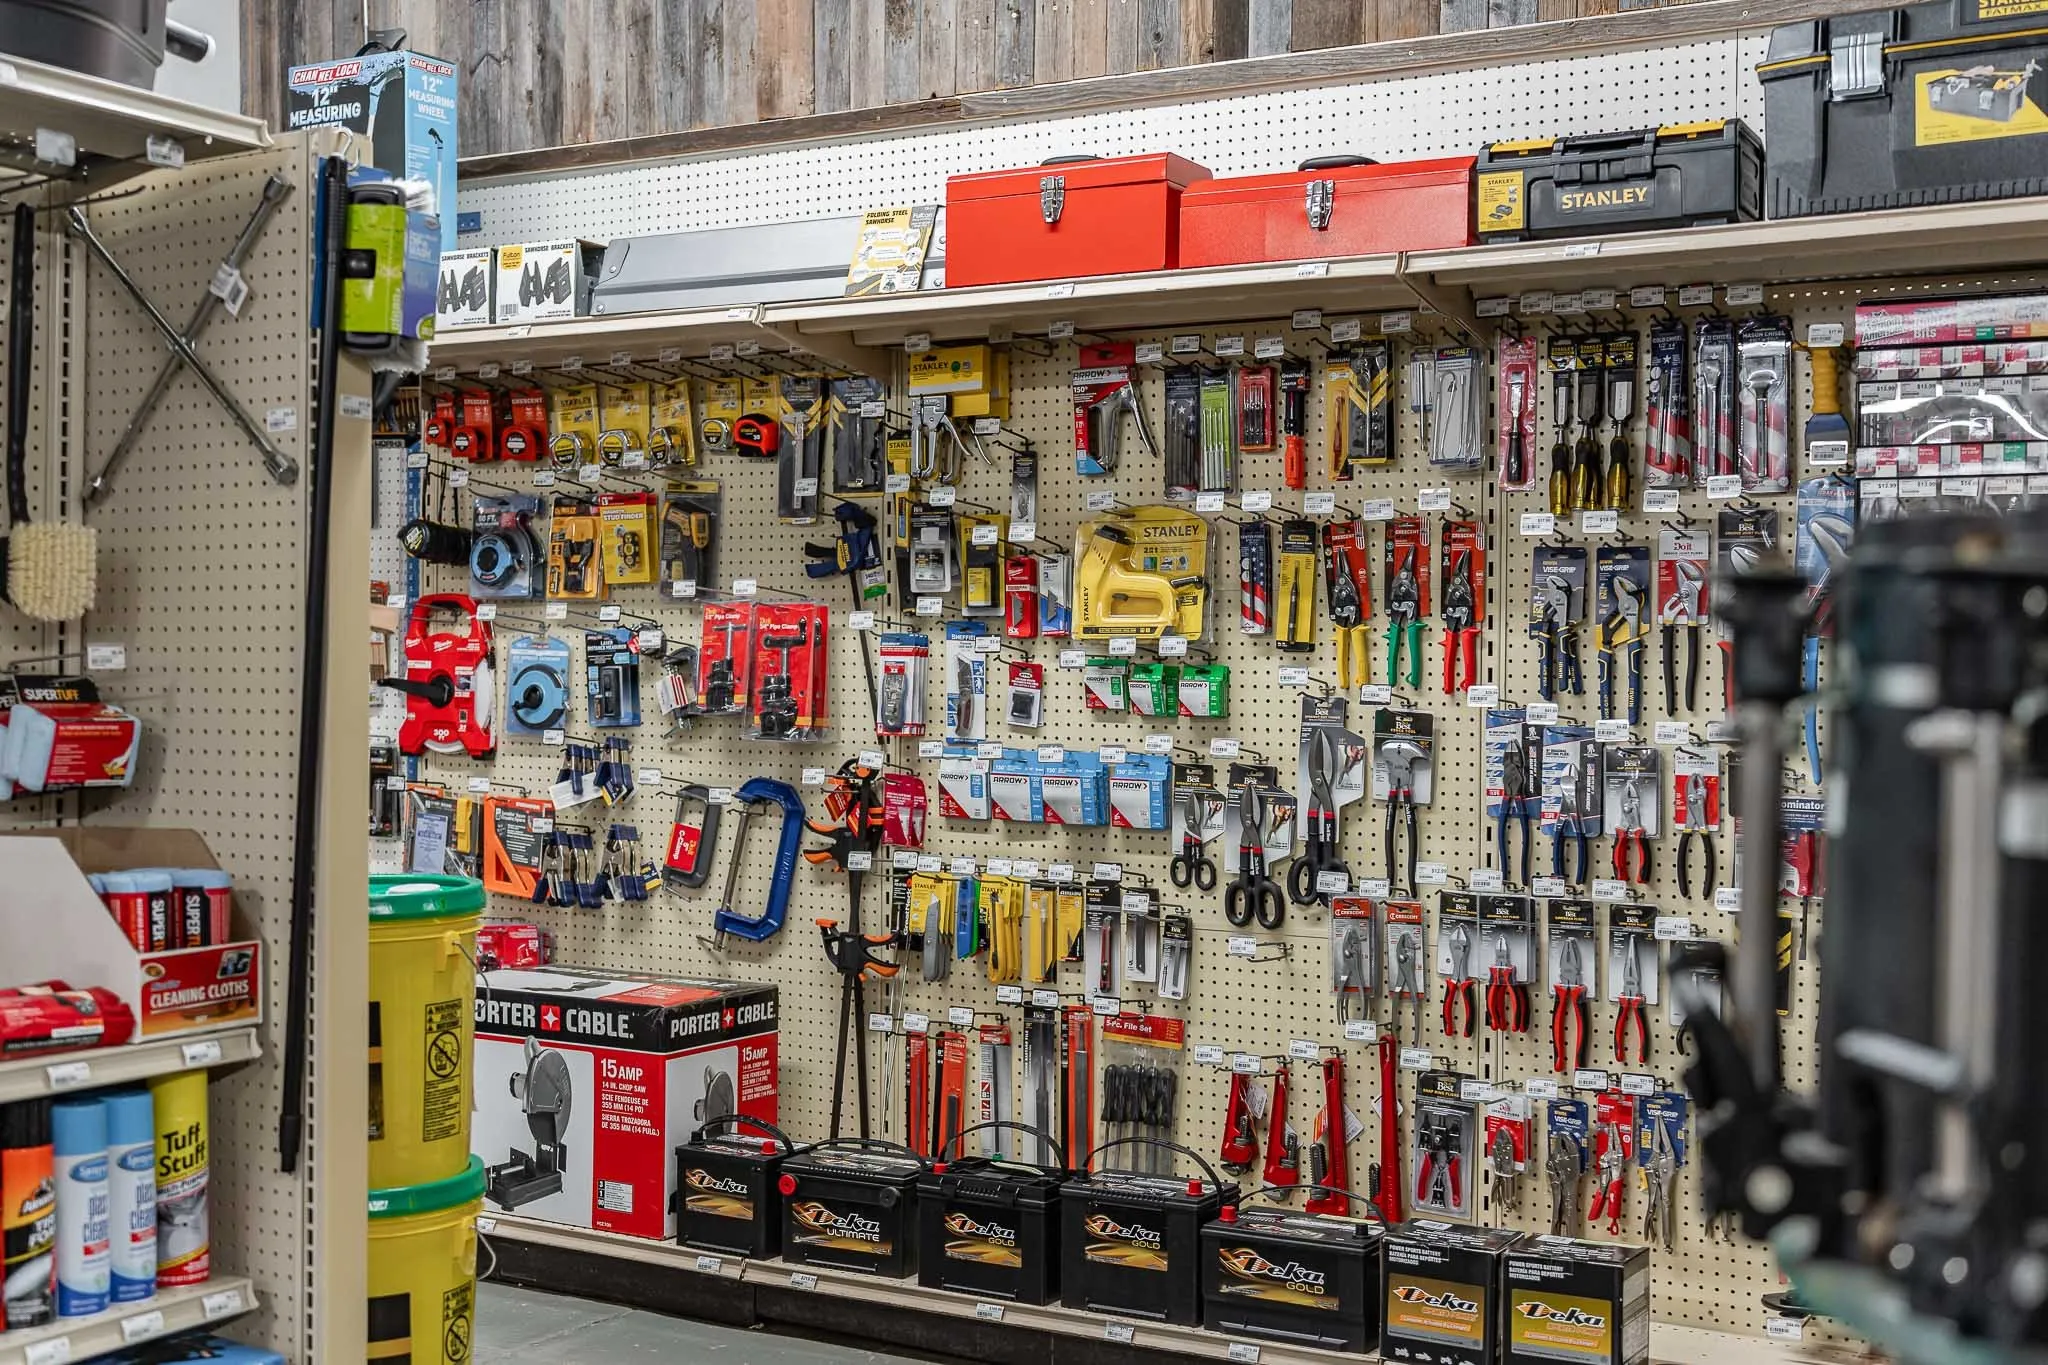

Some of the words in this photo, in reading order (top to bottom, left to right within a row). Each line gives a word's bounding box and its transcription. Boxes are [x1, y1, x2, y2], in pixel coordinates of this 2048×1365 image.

[421, 75, 443, 93] 12"
[312, 87, 338, 107] 12"
[409, 90, 456, 108] MEASURING
[289, 103, 361, 127] MEASURING
[417, 103, 447, 119] WHEEL
[1561, 187, 1648, 209] STANLEY
[467, 252, 489, 260] BRACKETS
[1742, 331, 1763, 339] MASON
[912, 362, 949, 372] STANLEY
[1072, 370, 1105, 379] ARROW
[603, 513, 620, 521] STUD
[621, 512, 644, 520] FINDER
[1143, 525, 1200, 538] STANLEY
[1738, 523, 1755, 532] Best
[1332, 534, 1355, 542] CRESCENT
[1542, 566, 1577, 574] VISE-GRIP
[1599, 564, 1630, 572] VISE-GRIP
[715, 613, 724, 621] Pipe
[725, 612, 741, 621] Clamp
[781, 623, 799, 631] Clamp
[23, 688, 79, 701] SUPERTUFF
[1315, 707, 1329, 716] Best
[1395, 721, 1411, 730] Best
[433, 729, 449, 737] 300
[940, 773, 965, 781] ARROW
[993, 776, 1023, 785] ARROW
[1186, 775, 1201, 783] Best
[1044, 779, 1073, 788] ARROW
[1112, 782, 1143, 791] ARROW
[1779, 800, 1826, 811] ominator
[673, 830, 686, 861] C-Clamp
[981, 886, 1004, 895] STANLEY
[904, 888, 912, 936] GreatNeck
[1495, 907, 1510, 915] Best
[150, 986, 206, 1009] CLEANING
[208, 979, 249, 998] CLOTHS
[475, 999, 537, 1028] ORTER
[670, 1011, 720, 1039] PORTER
[1106, 1019, 1123, 1029] 5-Pc.
[1123, 1021, 1139, 1031] File
[1139, 1024, 1153, 1033] Set
[742, 1046, 752, 1062] 15
[752, 1047, 768, 1060] AMP
[601, 1057, 618, 1079] 15
[618, 1065, 644, 1082] AMP
[602, 1081, 609, 1089] 14
[610, 1082, 618, 1090] IN.
[618, 1083, 633, 1091] CHOP
[634, 1084, 647, 1093] SAW
[1436, 1082, 1454, 1092] Best
[601, 1093, 614, 1101] SCIE
[614, 1094, 641, 1105] FENDEUSE
[642, 1098, 649, 1106] DE
[601, 1101, 613, 1109] 355
[624, 1104, 634, 1112] (14
[634, 1106, 644, 1114] PO)
[1646, 1109, 1679, 1118] VISE-GRIP
[601, 1113, 621, 1122] SIERRA
[621, 1116, 651, 1127] TROZADORA
[1554, 1115, 1582, 1125] VISE-GRIP
[601, 1121, 609, 1129] DE
[609, 1122, 620, 1130] 355
[621, 1124, 631, 1132] MM
[632, 1125, 642, 1134] (14
[642, 1127, 660, 1137] PULG.)
[163, 1122, 201, 1154] Tuff
[159, 1140, 205, 1177] Stuff
[826, 1227, 880, 1243] ULTIMATE
[988, 1237, 1015, 1247] GOLD
[1131, 1239, 1161, 1250] GOLD
[1421, 1248, 1442, 1257] BATTERY
[1388, 1256, 1420, 1266] MOTORIZADOS
[1419, 1254, 1442, 1263] DEPORTES
[1508, 1260, 1524, 1268] POWER
[1542, 1264, 1564, 1272] BATTERY
[1508, 1272, 1541, 1282] MOTORIZADOS
[1540, 1270, 1564, 1279] DEPORTES
[1286, 1281, 1325, 1295] GOLD
